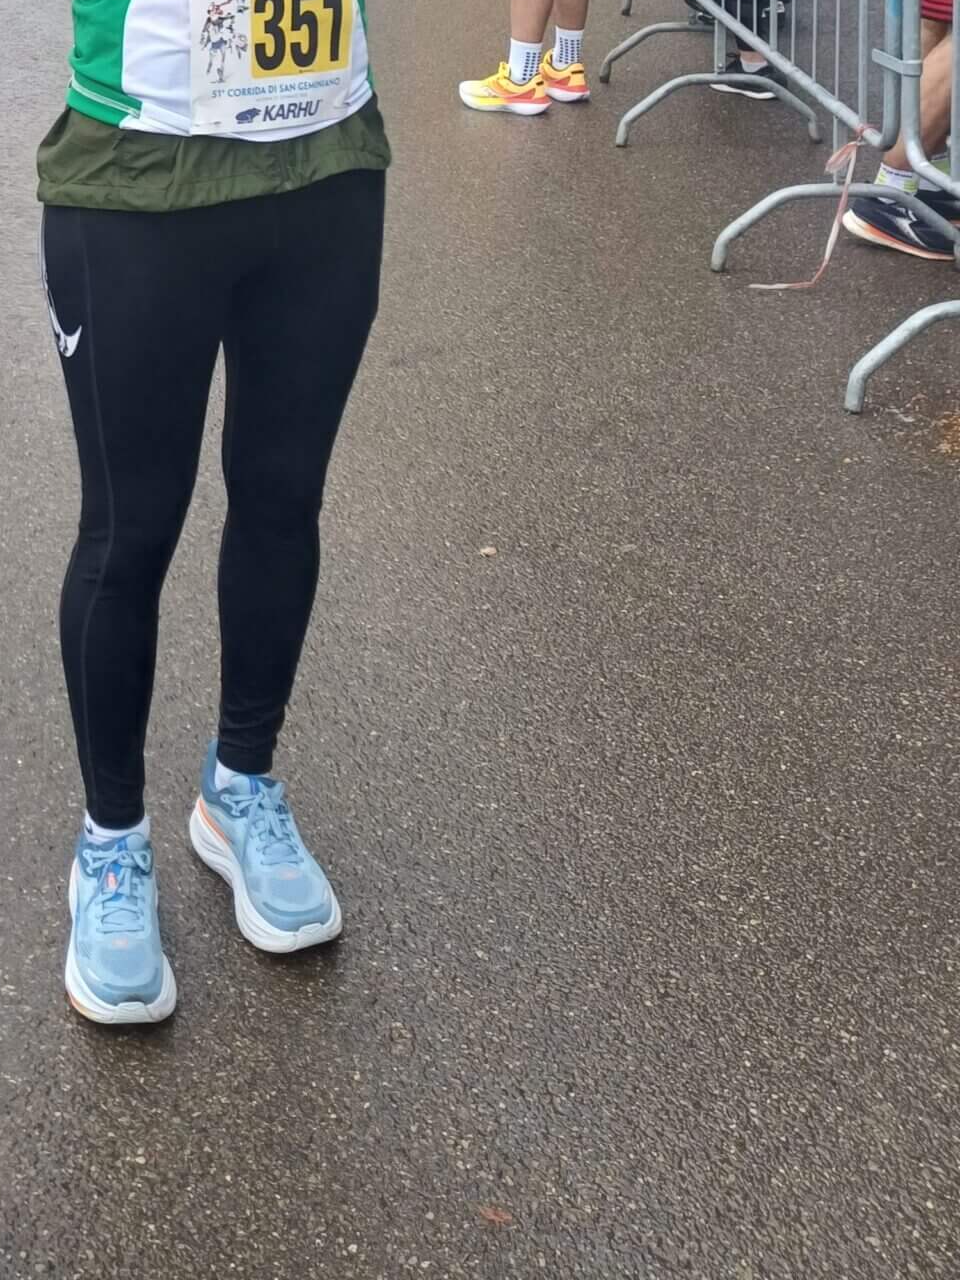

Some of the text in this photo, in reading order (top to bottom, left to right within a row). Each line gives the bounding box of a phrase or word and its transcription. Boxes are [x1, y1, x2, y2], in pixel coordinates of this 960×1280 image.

[227, 85, 266, 97] CORRIDA
[268, 84, 278, 94] DI
[279, 83, 296, 93] SAN
[262, 99, 321, 122] KARHU
